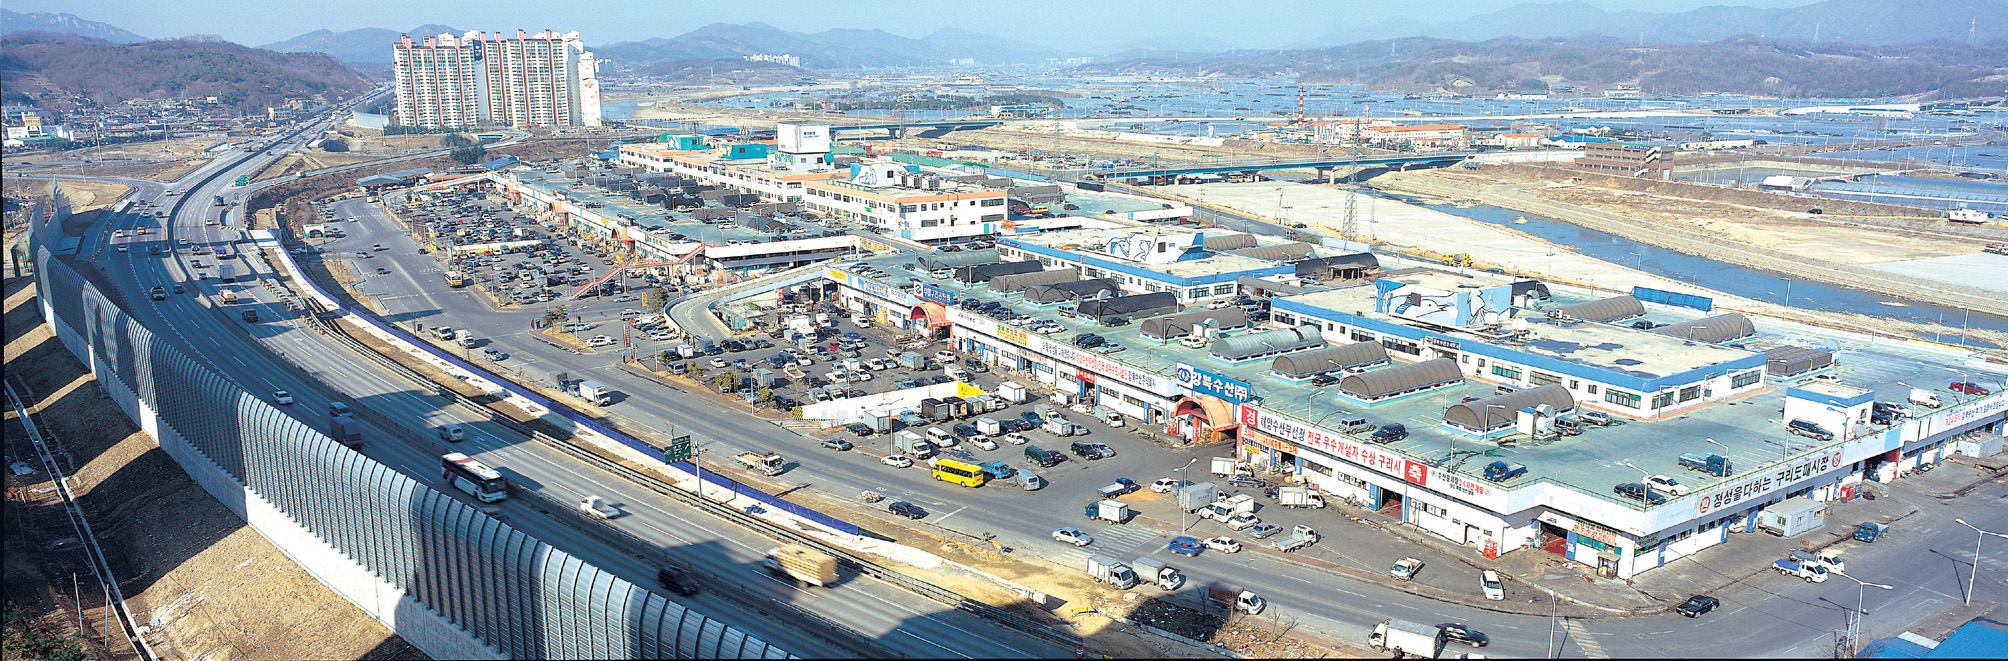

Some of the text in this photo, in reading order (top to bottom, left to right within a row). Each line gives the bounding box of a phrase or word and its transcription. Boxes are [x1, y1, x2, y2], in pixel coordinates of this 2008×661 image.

[1246, 409, 1256, 425] 경
[1260, 415, 1306, 442] 해양수산부선정
[1307, 431, 1321, 446] 전국
[1361, 449, 1376, 465] 수상
[1378, 454, 1402, 475] 구리시
[1408, 463, 1422, 483] 축
[1776, 456, 1829, 487] 구리도매시장
